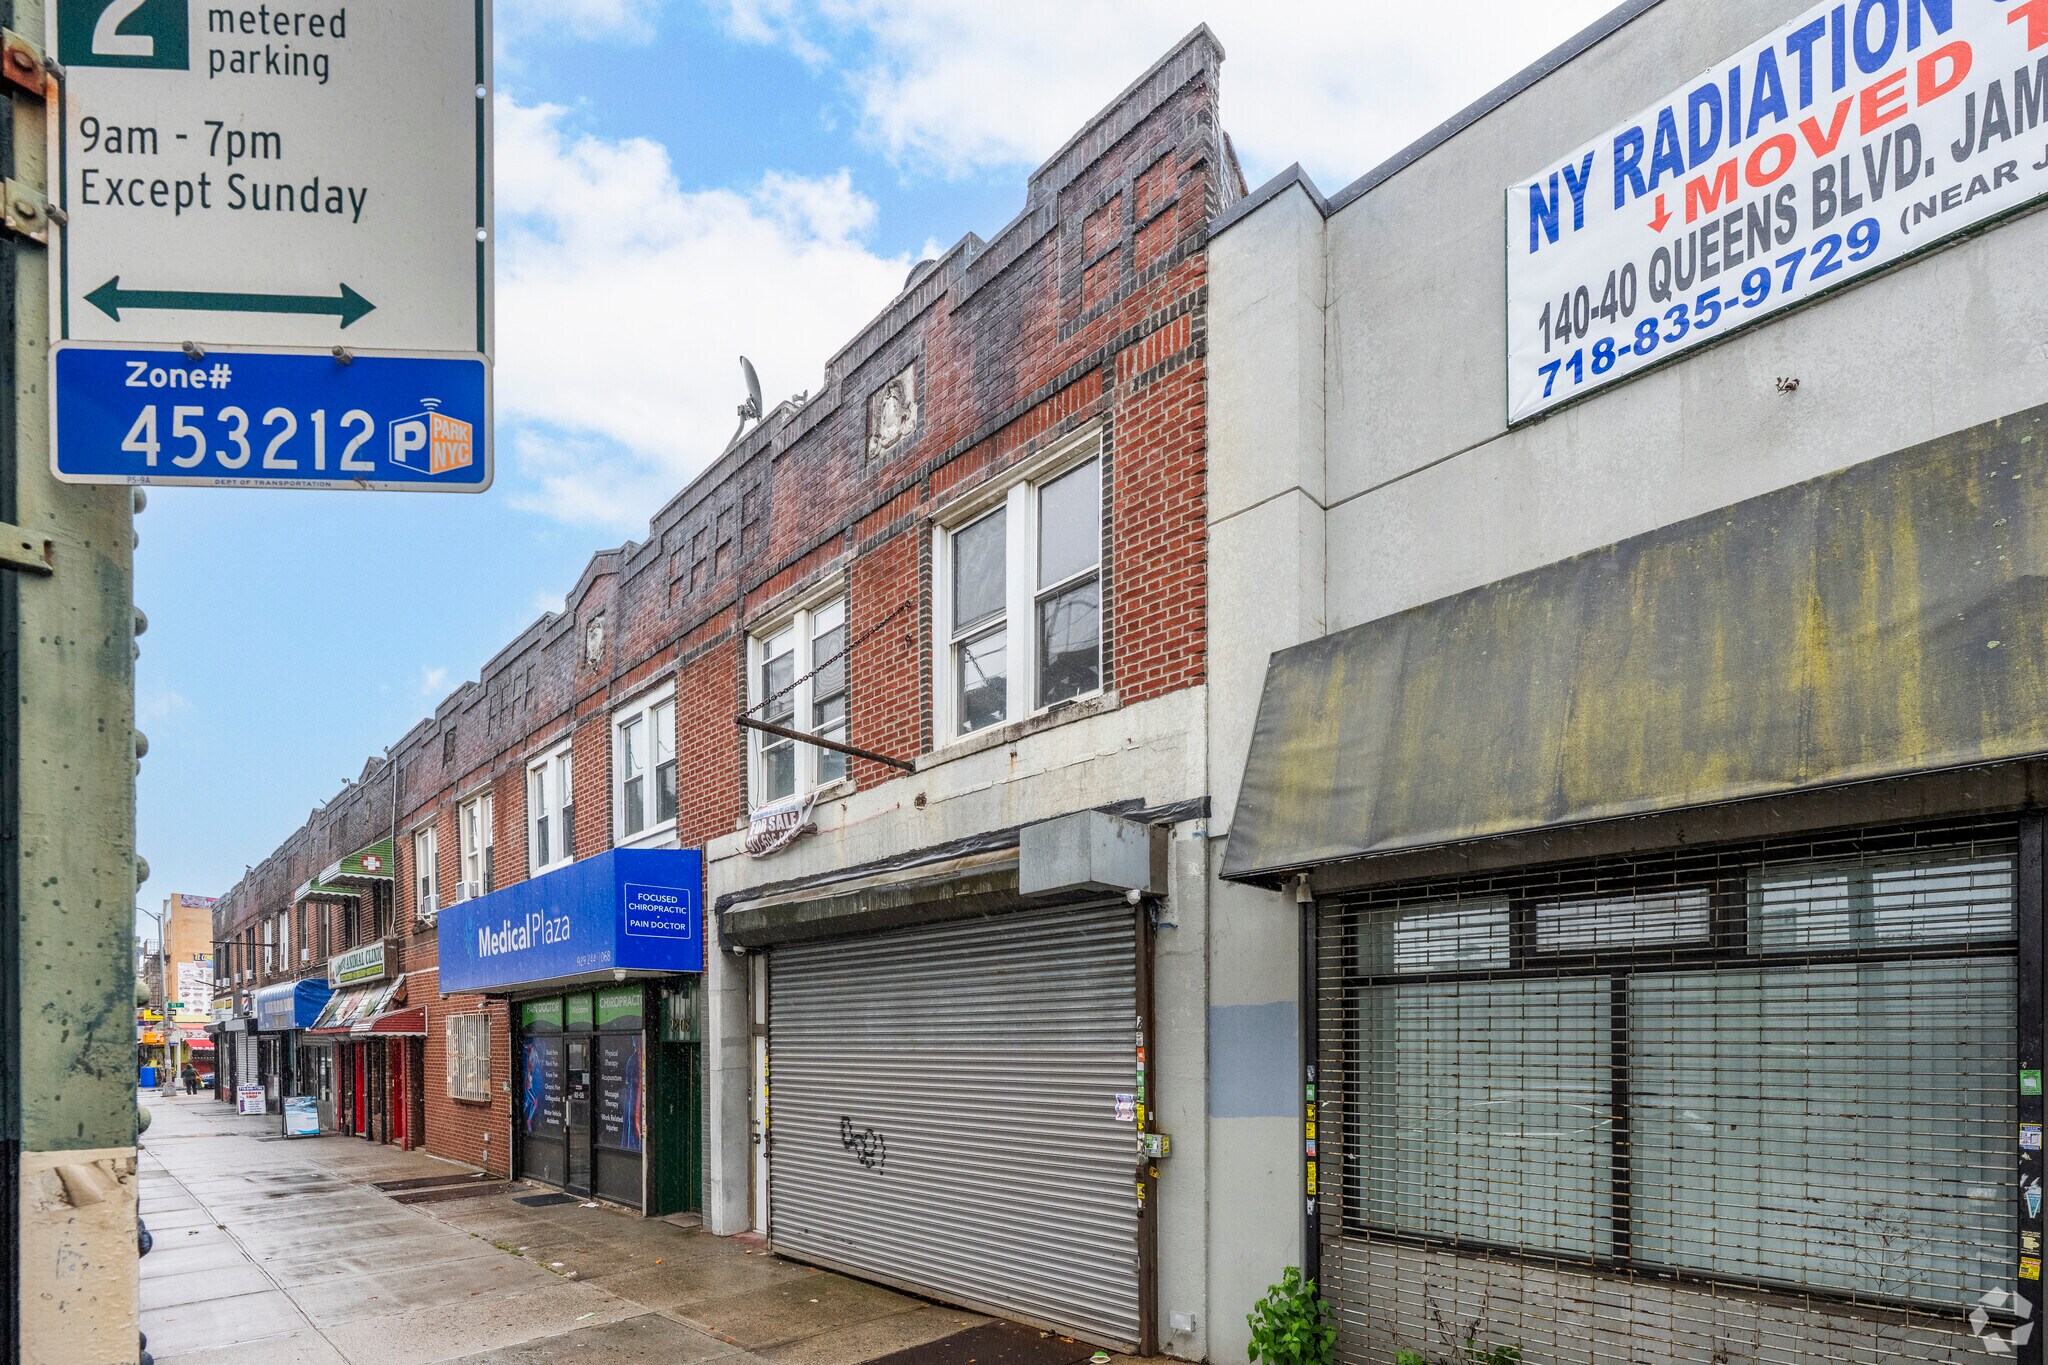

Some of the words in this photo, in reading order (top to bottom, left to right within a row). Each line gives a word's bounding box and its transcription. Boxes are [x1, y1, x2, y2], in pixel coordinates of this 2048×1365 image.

[208, 4, 346, 38] metered
[208, 44, 330, 85] parking
[1530, 150, 1594, 254] NY
[1613, 0, 1953, 210] RADIATION
[1685, 40, 1973, 225] MOVED
[79, 116, 158, 155] 9am
[204, 120, 281, 166] 7pm
[82, 168, 211, 216] Except
[227, 173, 367, 224] Sunday
[1538, 262, 1637, 354] 140-40
[1649, 184, 1796, 303] QUEENS
[1812, 123, 1935, 230] BLVD.
[1538, 217, 1880, 398] 718-835-9729
[1900, 160, 2020, 235] (NEAR
[125, 361, 233, 390] Zone#
[120, 404, 375, 472] 453212
[394, 420, 427, 463] P
[433, 417, 469, 442] PARK
[433, 441, 470, 469] NYC
[215, 479, 237, 487] DEPT
[254, 480, 332, 488] TRANSPORTATION
[750, 818, 767, 836] FOR
[768, 811, 797, 832] SALE
[628, 903, 687, 915] CHIROPRACTIC
[637, 893, 678, 904] FOCUSED
[478, 914, 530, 958] Medical
[532, 909, 571, 947] Plaza
[630, 920, 650, 928] PAIN
[651, 921, 686, 931] DOCTOR
[538, 1002, 560, 1013] DOCTOR
[604, 1050, 618, 1058] Physical
[604, 1060, 618, 1068] Therapy
[601, 1074, 622, 1082] Acupuncture
[604, 1090, 619, 1099] Massage
[605, 1100, 619, 1109] Therapy
[605, 1124, 618, 1132] Injuries
